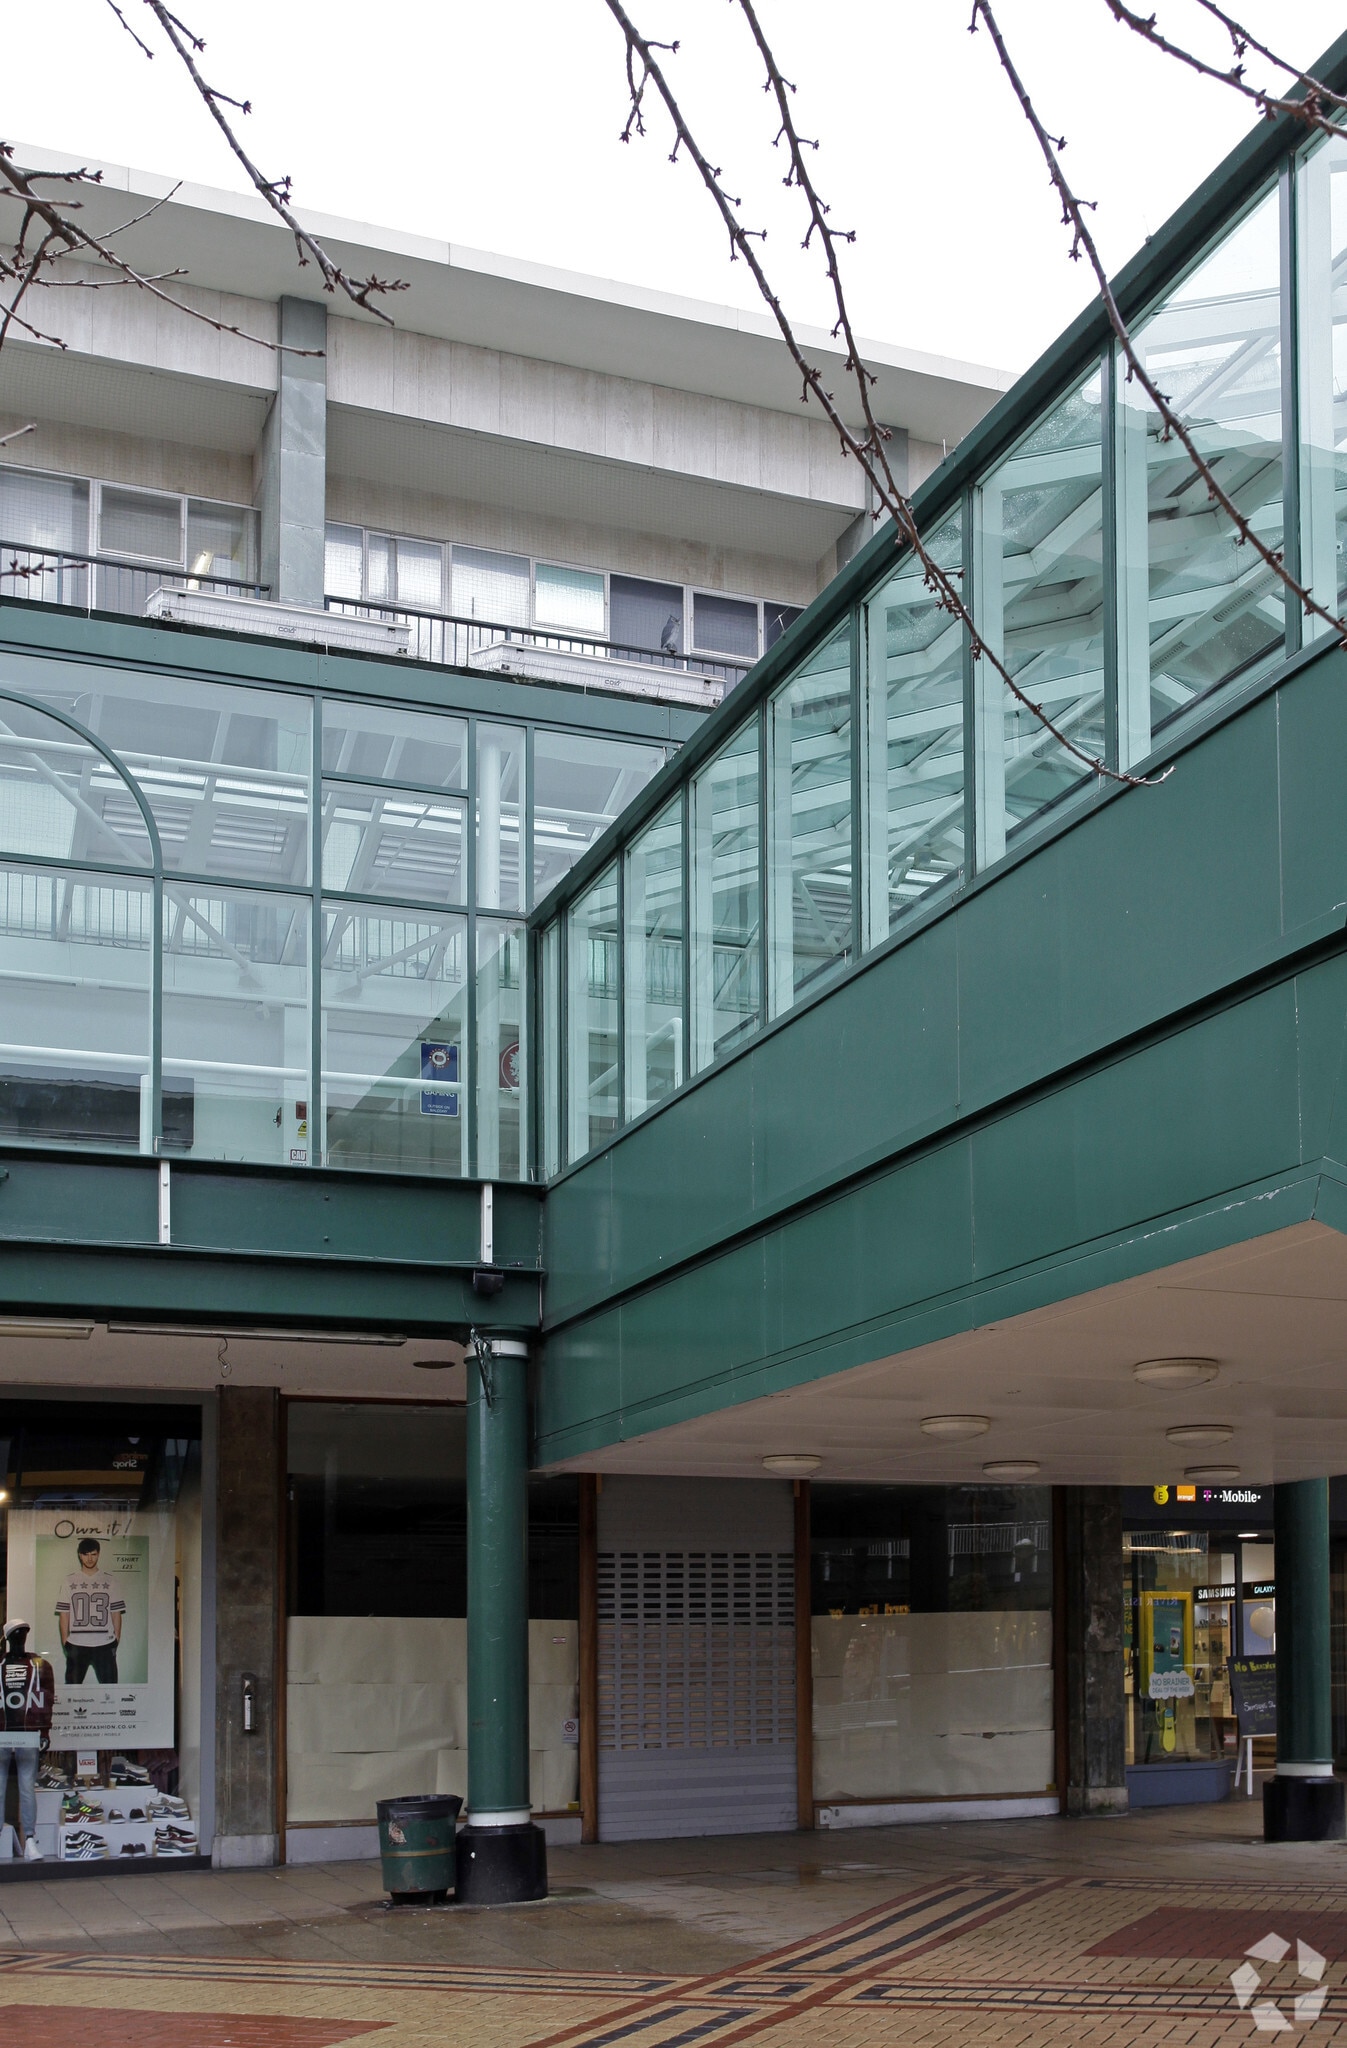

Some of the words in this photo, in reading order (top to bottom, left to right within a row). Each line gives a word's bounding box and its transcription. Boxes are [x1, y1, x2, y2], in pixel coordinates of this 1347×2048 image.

[55, 1520, 102, 1538] Own
[1198, 1587, 1235, 1599] SAMSUNG
[72, 1592, 109, 1627] 03
[1163, 1678, 1189, 1686] BRAINER
